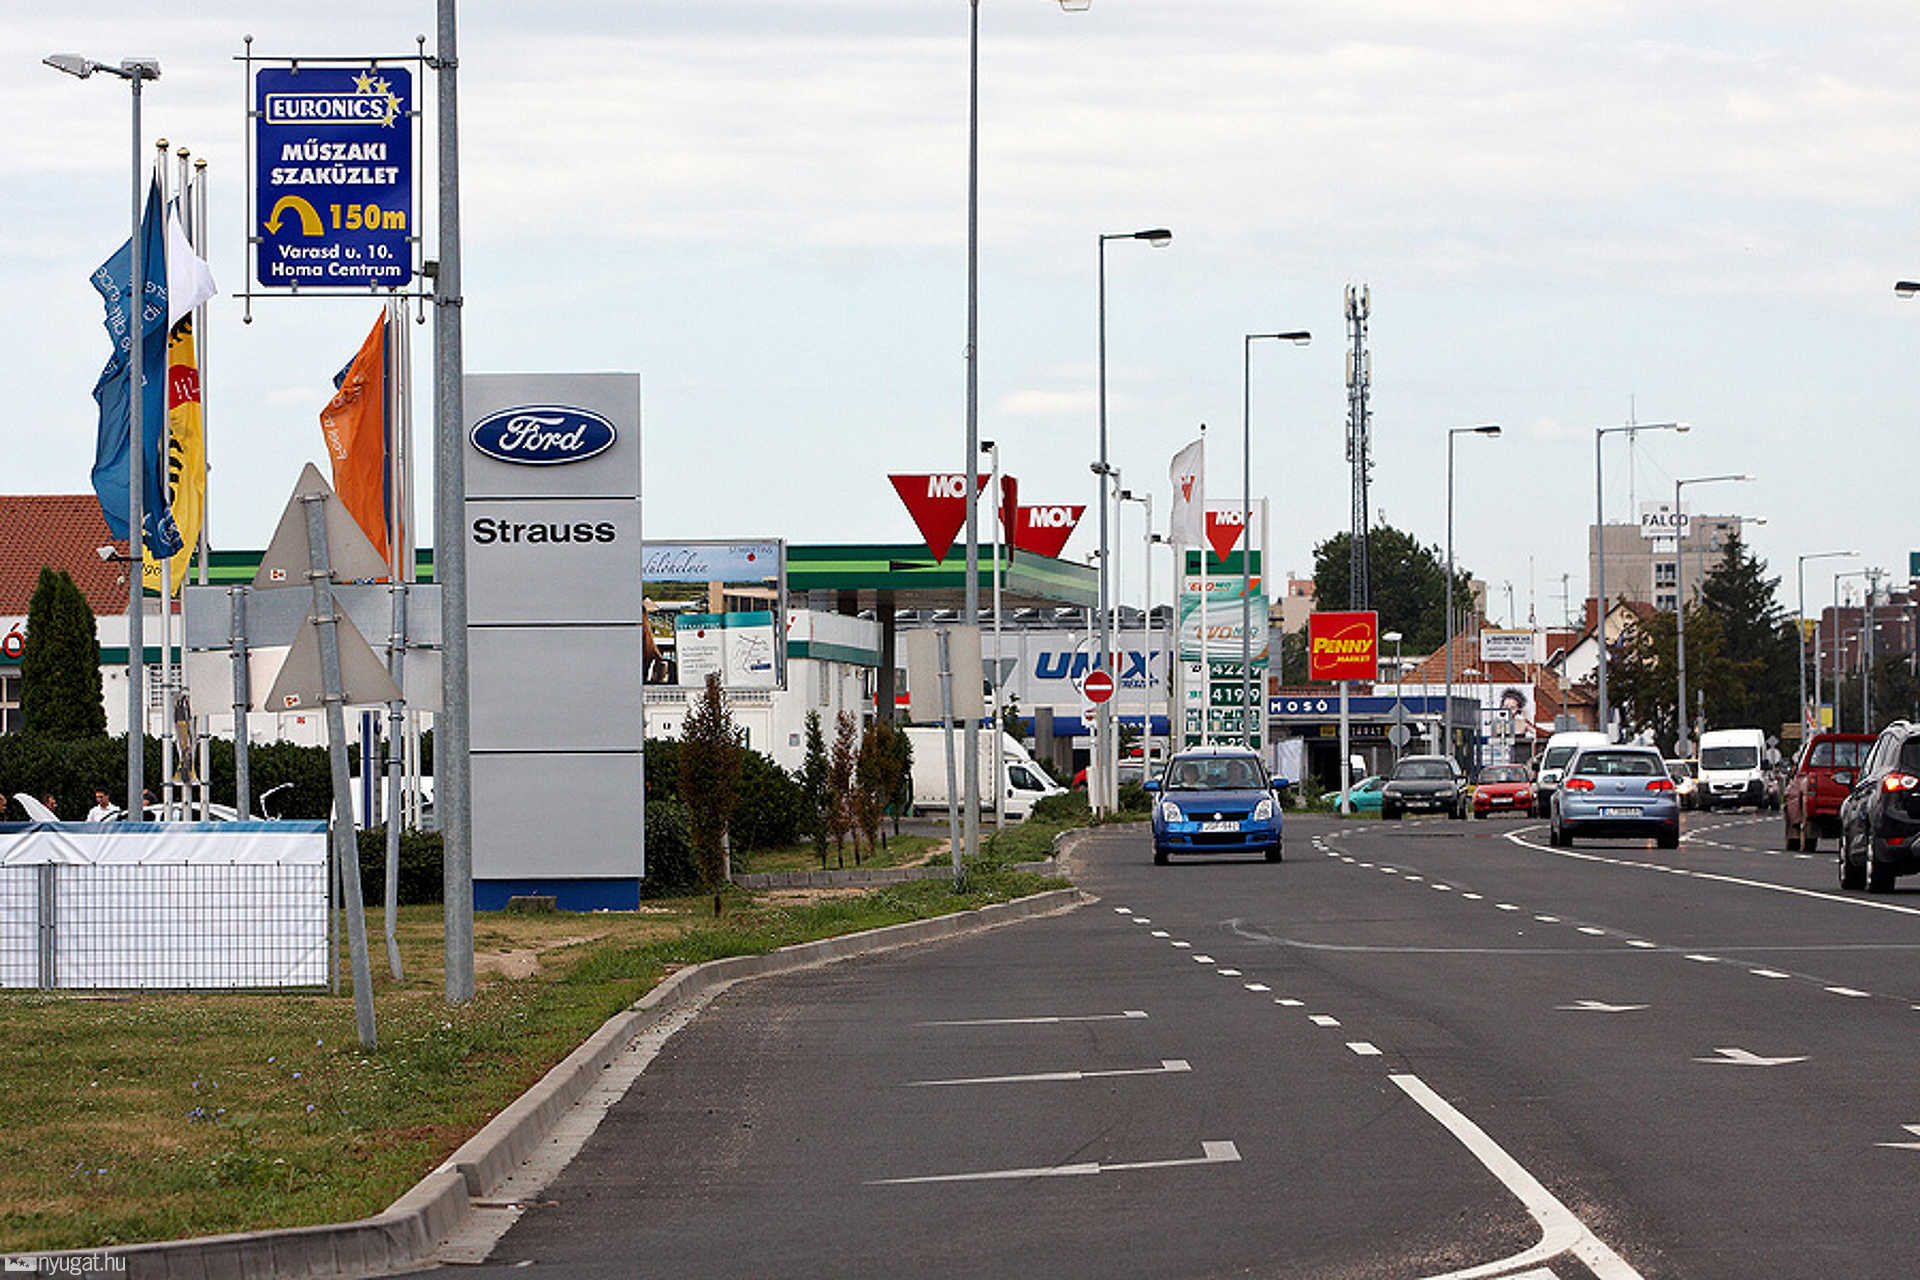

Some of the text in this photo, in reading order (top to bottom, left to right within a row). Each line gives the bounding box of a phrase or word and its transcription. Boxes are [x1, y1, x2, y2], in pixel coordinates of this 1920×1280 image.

[273, 99, 384, 118] EURONICS
[281, 138, 388, 161] MŰSZAKI
[271, 163, 399, 185] SZAKÜZLET
[329, 204, 406, 229] 150m
[278, 244, 394, 259] Varasd u. 10.
[272, 262, 401, 277] Homa Centrum
[499, 415, 588, 451] Ford
[927, 475, 979, 498] MO
[1028, 507, 1077, 528] MOL
[1642, 513, 1689, 526] FALCO
[472, 518, 616, 544] Strauss
[1313, 637, 1373, 654] PENNY
[1337, 655, 1371, 663] MARKET
